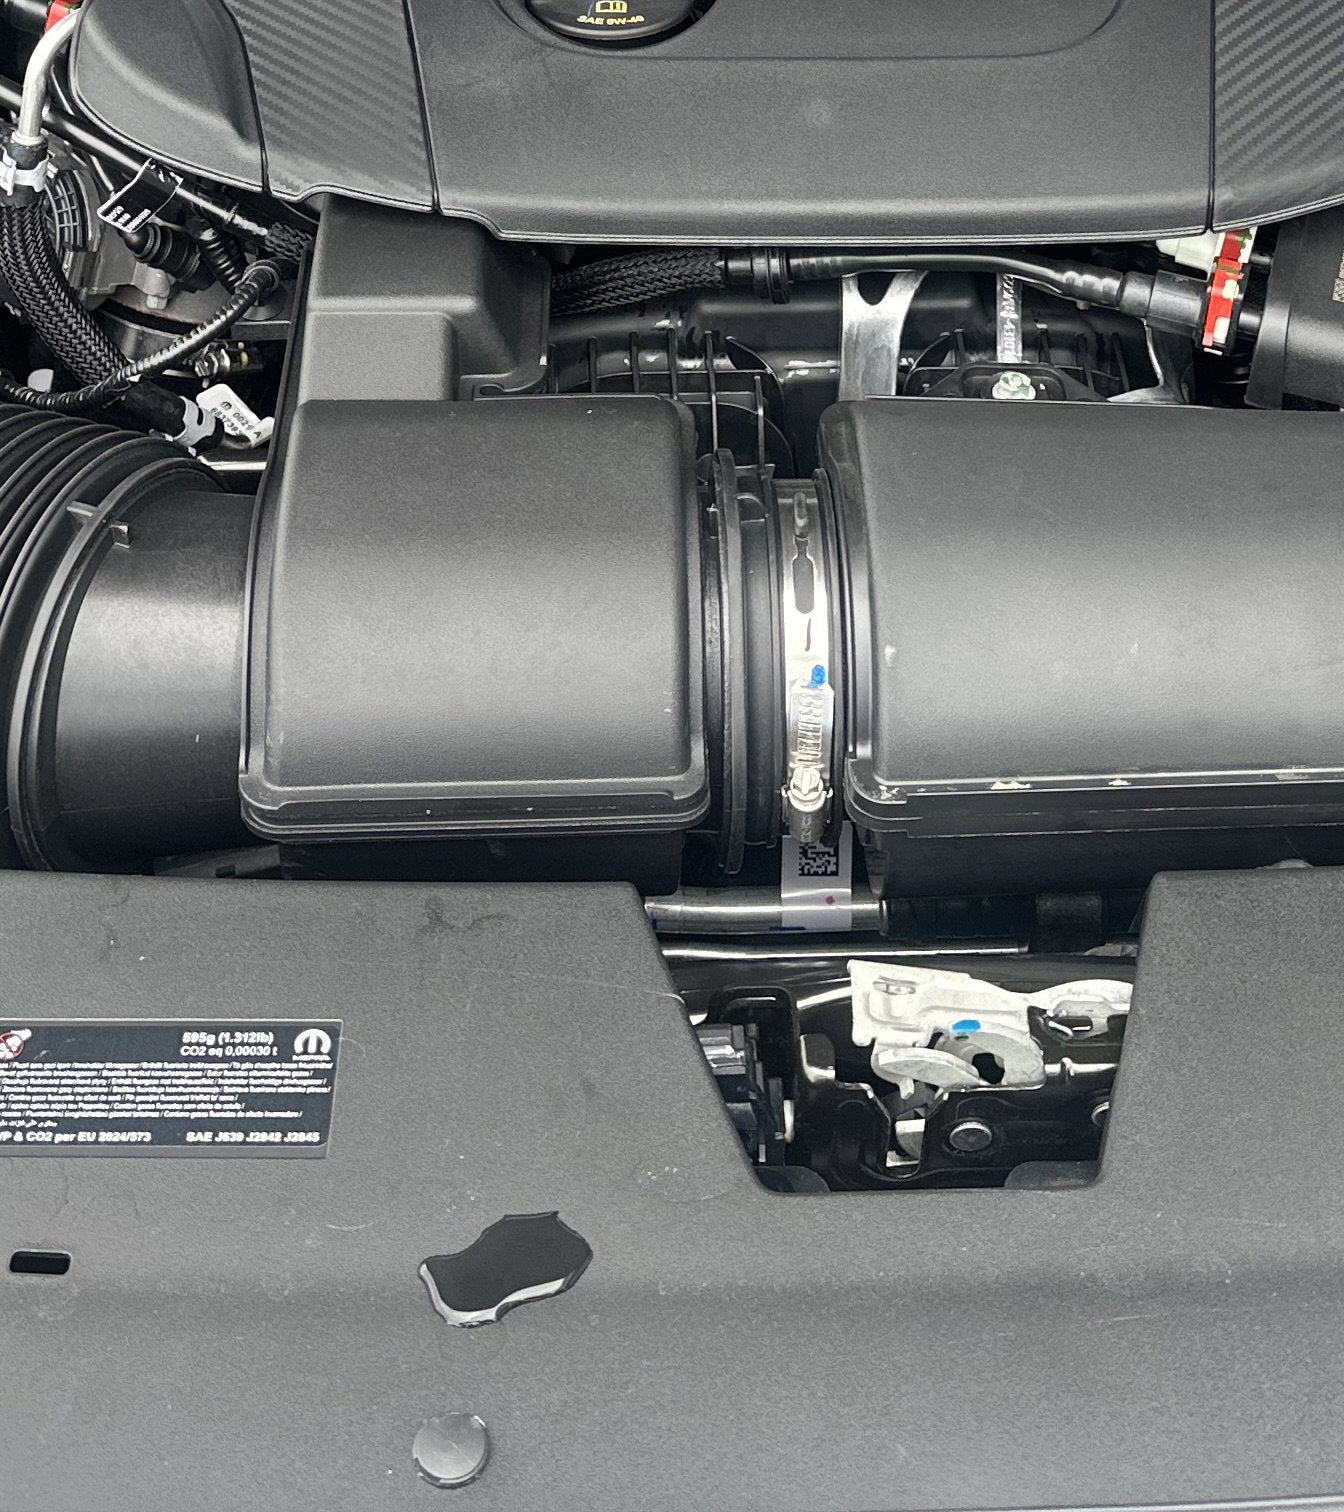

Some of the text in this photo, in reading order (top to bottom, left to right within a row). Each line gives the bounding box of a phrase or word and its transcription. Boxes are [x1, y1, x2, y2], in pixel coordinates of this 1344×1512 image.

[576, 15, 605, 25] SAE
[180, 1046, 207, 1056] CO2
[26, 1131, 53, 1142] CO2
[54, 1133, 76, 1144] per
[77, 1131, 96, 1142] EU
[185, 1131, 214, 1142] SAE
